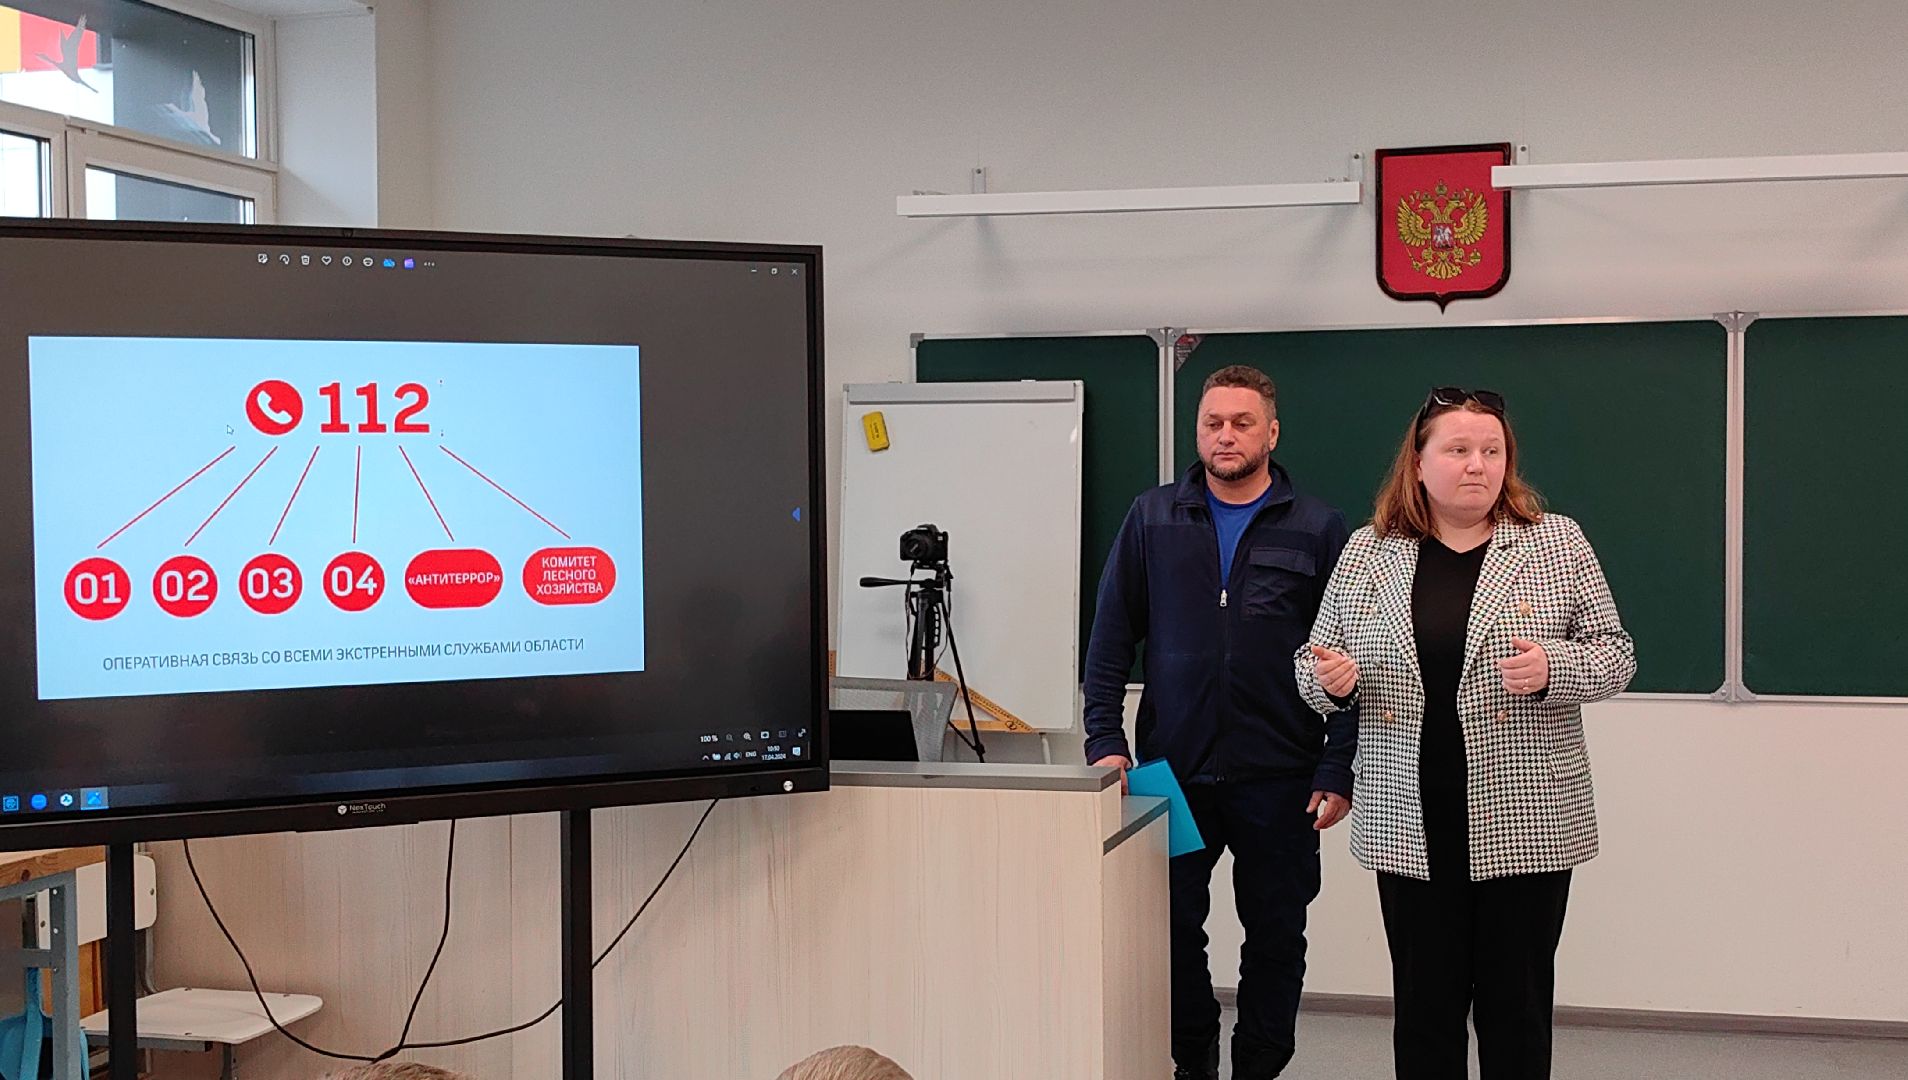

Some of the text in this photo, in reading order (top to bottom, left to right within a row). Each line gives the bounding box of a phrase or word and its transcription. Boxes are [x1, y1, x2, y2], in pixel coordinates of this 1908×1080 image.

[319, 382, 430, 433] 112
[541, 555, 597, 568] КОМИТЕТ
[542, 568, 597, 582] ЛЕСНОГО
[74, 572, 122, 604] 01
[160, 569, 209, 602] 02
[247, 567, 294, 599] 03
[331, 565, 378, 597] 04
[408, 572, 501, 586] «АНТИТЕРРОР»
[536, 581, 603, 595] ХОЗЯЙСТВА
[102, 638, 584, 671] ОПЕРАТИВНАЯ СВЯЗЬ СО ВСЕМИ ЭКСТРЕННЫМИ СЛУЖБАМИ ОБЛАСТИ
